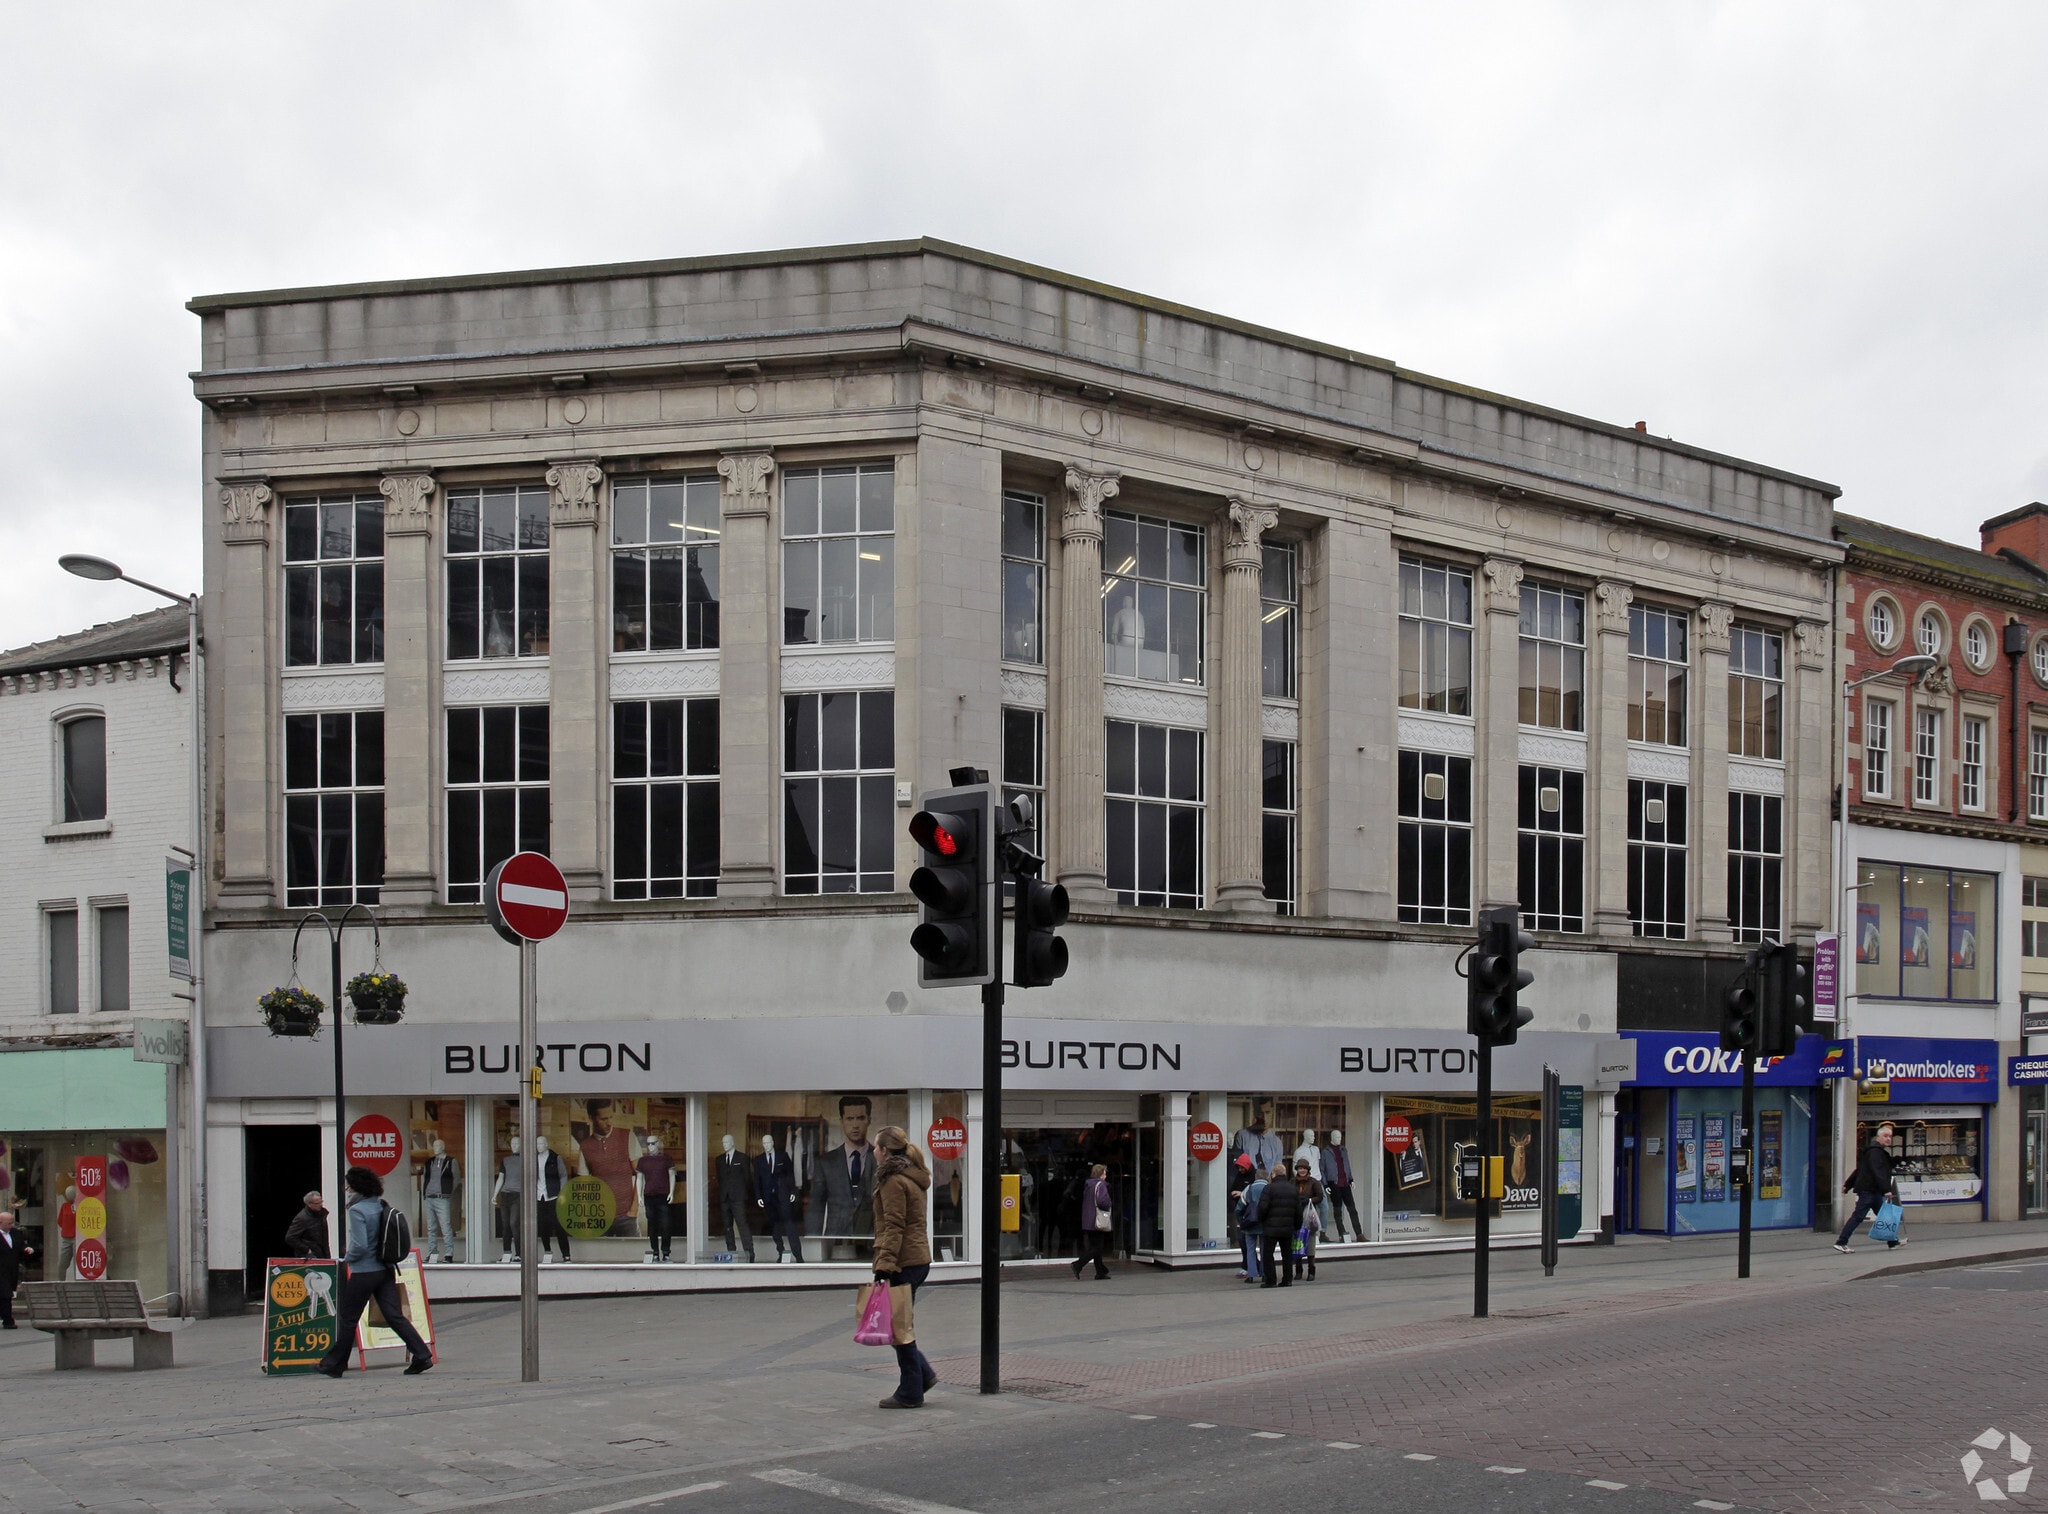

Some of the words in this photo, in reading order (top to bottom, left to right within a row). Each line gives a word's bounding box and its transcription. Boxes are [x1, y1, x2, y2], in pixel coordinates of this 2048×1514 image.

[170, 879, 186, 892] Street
[171, 890, 184, 902] light
[172, 902, 184, 911] out?
[1817, 947, 1835, 956] Problem
[143, 1029, 182, 1056] wallis
[445, 1042, 651, 1074] BURTON
[1001, 1040, 1181, 1071] BURTON
[1601, 1064, 1629, 1073] BURTON
[1819, 1065, 1845, 1074] CORAL
[932, 1128, 963, 1141] SALE
[1385, 1126, 1409, 1136] SALE
[351, 1132, 396, 1148] SALE
[1193, 1132, 1219, 1143] SALE
[352, 1150, 396, 1159] CONTINUES
[80, 1168, 101, 1187] 50%
[572, 1183, 601, 1192] LIMITED
[1945, 1188, 1955, 1196] gold
[572, 1192, 601, 1200] PERIOD
[81, 1206, 101, 1216] SPRING
[567, 1203, 606, 1218] POLOS
[81, 1216, 101, 1230] SALE
[566, 1219, 573, 1229] 2
[574, 1221, 586, 1229] FOR
[586, 1219, 606, 1229] £30
[1874, 1221, 1897, 1233] ext
[80, 1250, 102, 1269] 50%
[276, 1281, 303, 1290] YALE
[276, 1290, 303, 1299] KEYS
[275, 1311, 305, 1329] Any
[274, 1333, 331, 1353] £1.99
